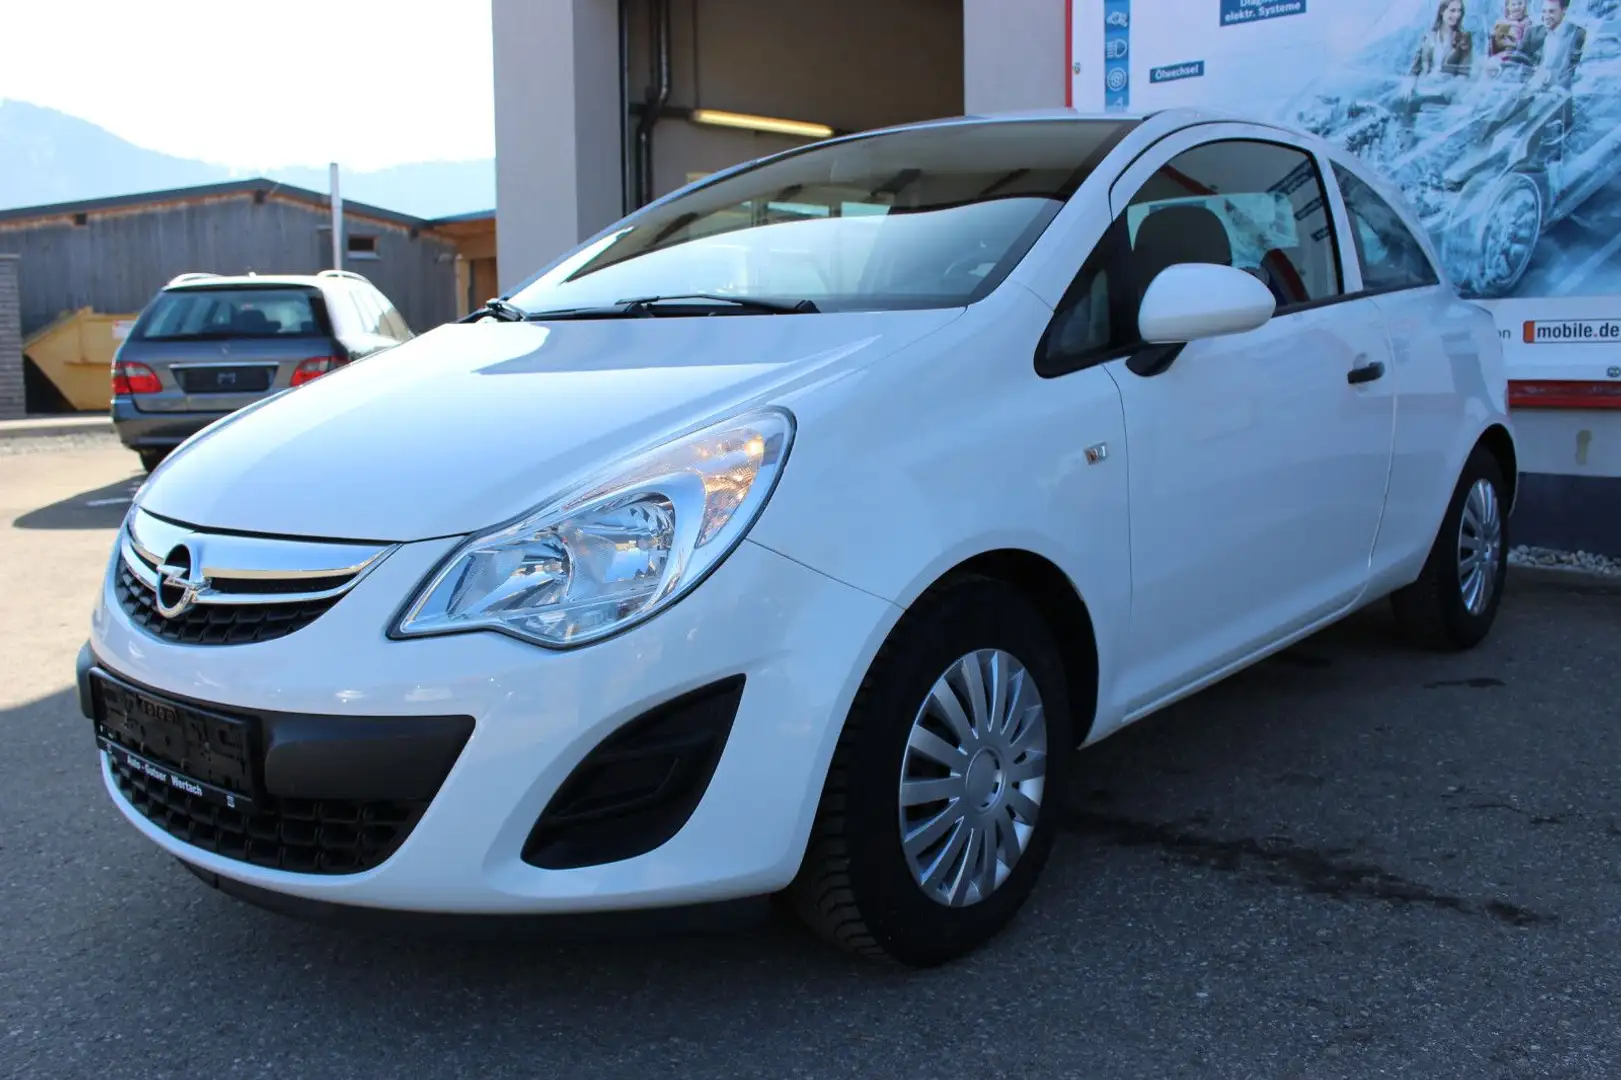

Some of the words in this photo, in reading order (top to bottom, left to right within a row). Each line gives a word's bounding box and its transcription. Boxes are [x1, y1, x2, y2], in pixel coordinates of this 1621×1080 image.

[1225, 9, 1256, 22] elektr.
[1258, 2, 1301, 17] Systeme
[1155, 63, 1199, 80] Ölwechsel
[1537, 322, 1620, 338] mobile.de
[170, 774, 203, 797] Wertach
